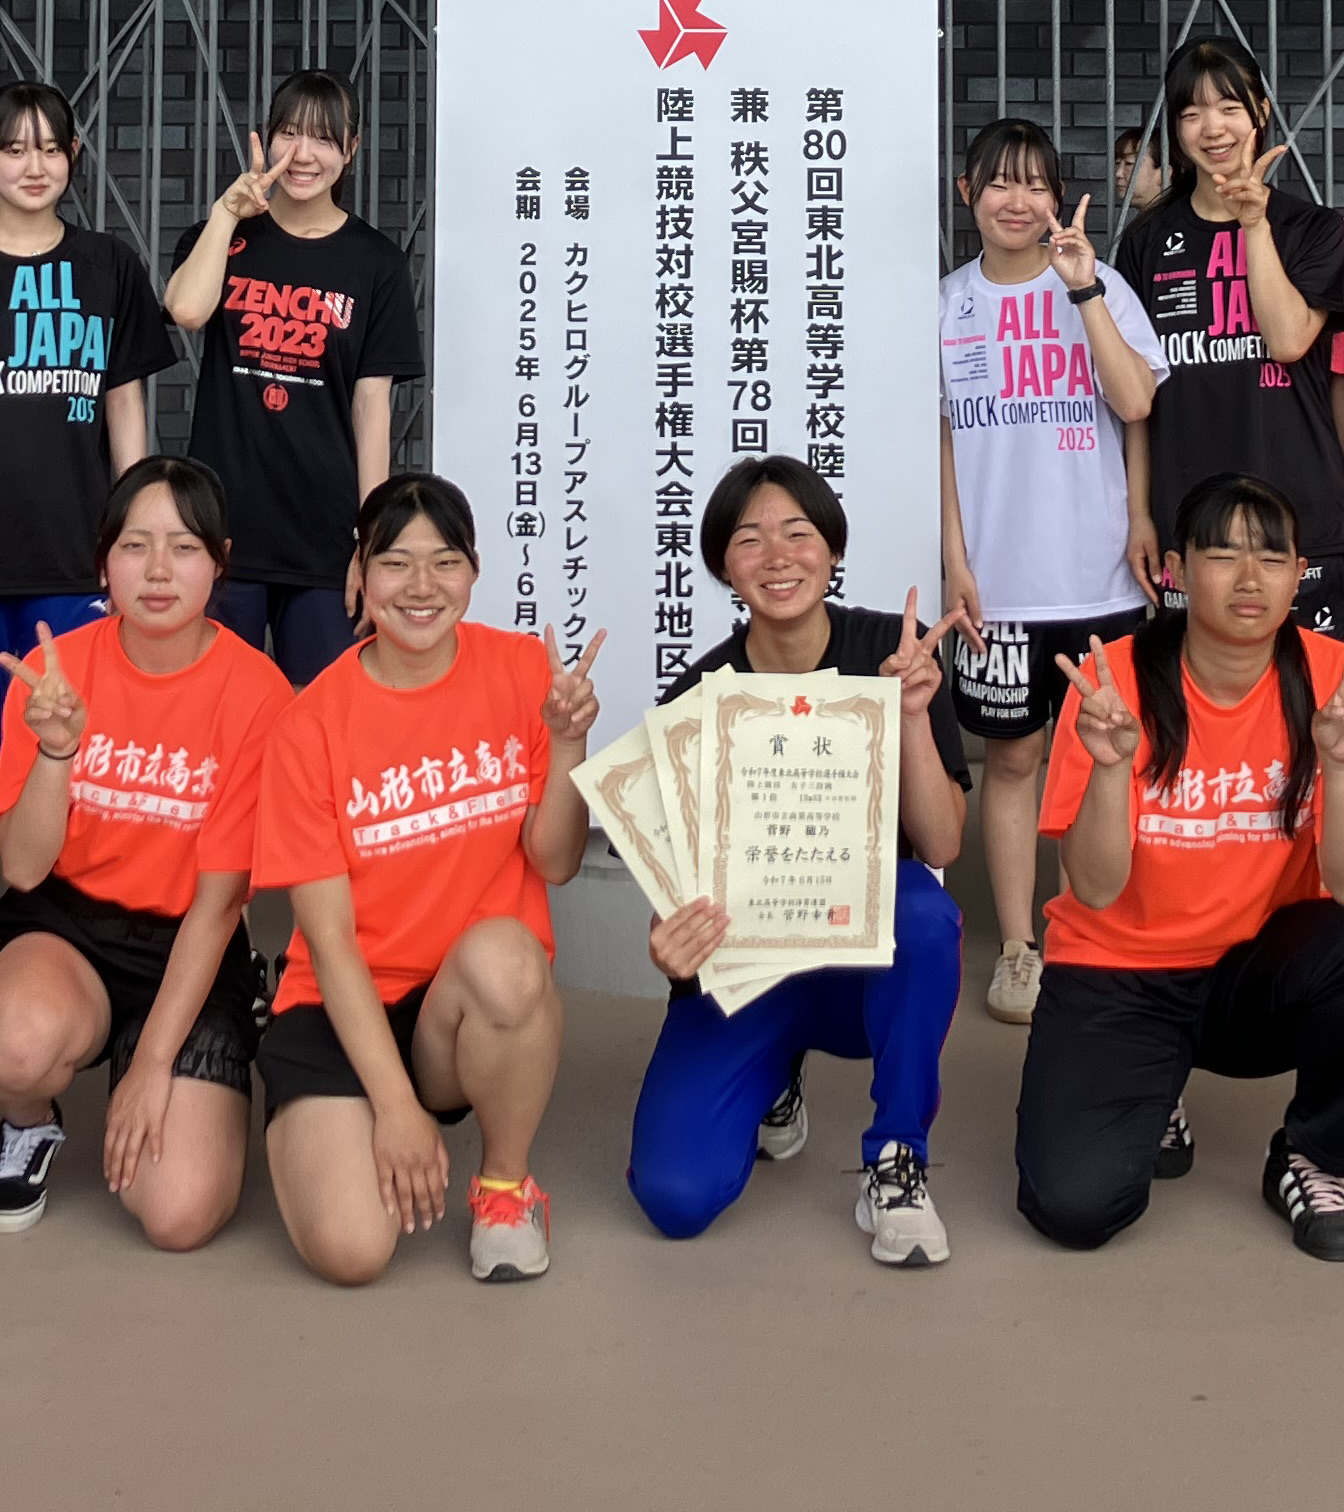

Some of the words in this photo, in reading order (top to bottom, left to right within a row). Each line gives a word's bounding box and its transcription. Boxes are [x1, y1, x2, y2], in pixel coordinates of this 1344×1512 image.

[8, 260, 81, 310] ALL
[224, 274, 355, 330] ZENCHU
[238, 312, 329, 358] 2023
[996, 289, 1060, 342] ALL
[7, 311, 115, 371] JAPA
[803, 87, 846, 600] 第80回東北高等学校陸
[999, 342, 1094, 399] JAPA
[1001, 399, 1094, 426] COMPETITION
[1056, 426, 1096, 451] 2025
[958, 676, 1030, 705] CHAMPIONSHIP
[744, 844, 852, 865] 栄誉をたたえる
